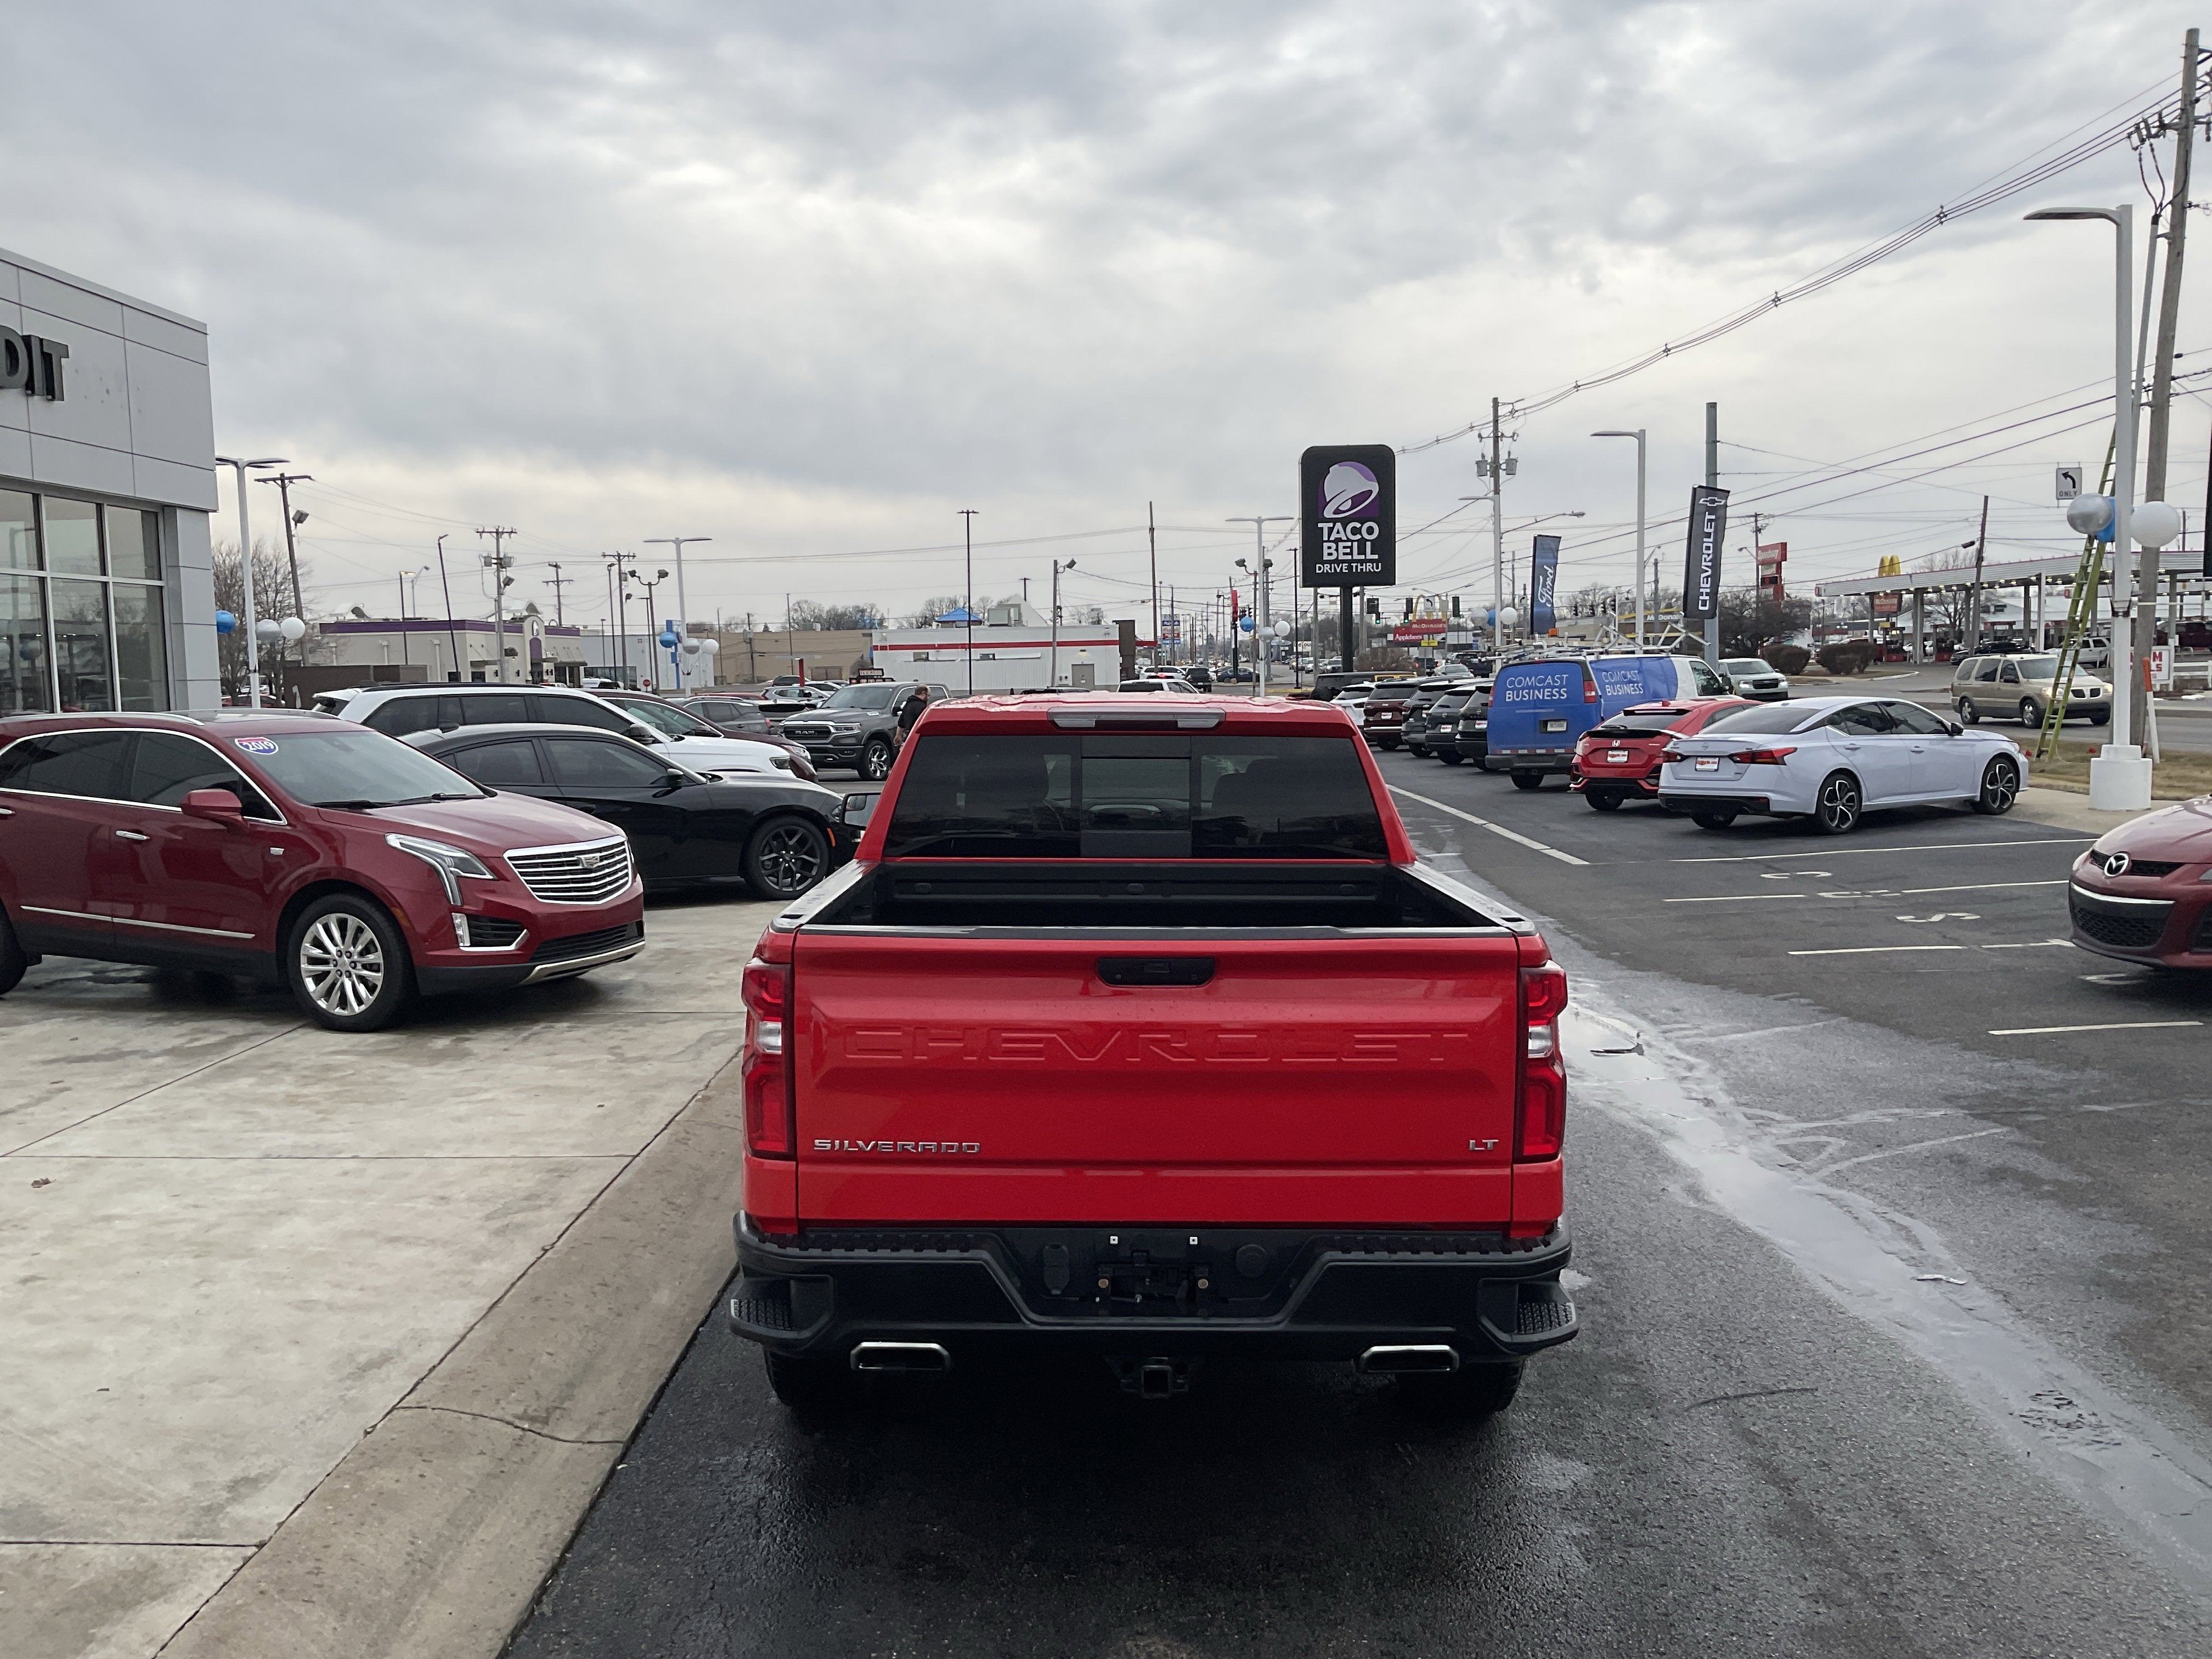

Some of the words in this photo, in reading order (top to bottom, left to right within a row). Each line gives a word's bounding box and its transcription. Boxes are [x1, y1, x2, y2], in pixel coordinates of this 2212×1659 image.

[1318, 521, 1379, 541] TACO
[1323, 541, 1379, 560] BELL
[1316, 563, 1348, 573] DRIVE
[1351, 562, 1381, 573] THRU
[1698, 511, 1716, 611] CHEVROLET
[1538, 565, 1554, 607] Ford
[1506, 674, 1569, 689] COMCAST
[1602, 670, 1639, 682] COMCAST
[1505, 688, 1567, 702] BUSINESS
[1605, 683, 1644, 696] BUSINESS
[243, 741, 274, 751] 2019
[844, 1025, 1469, 1062] CHEVROLET
[814, 1139, 980, 1153] SILVERADO
[1469, 1139, 1499, 1151] LT
